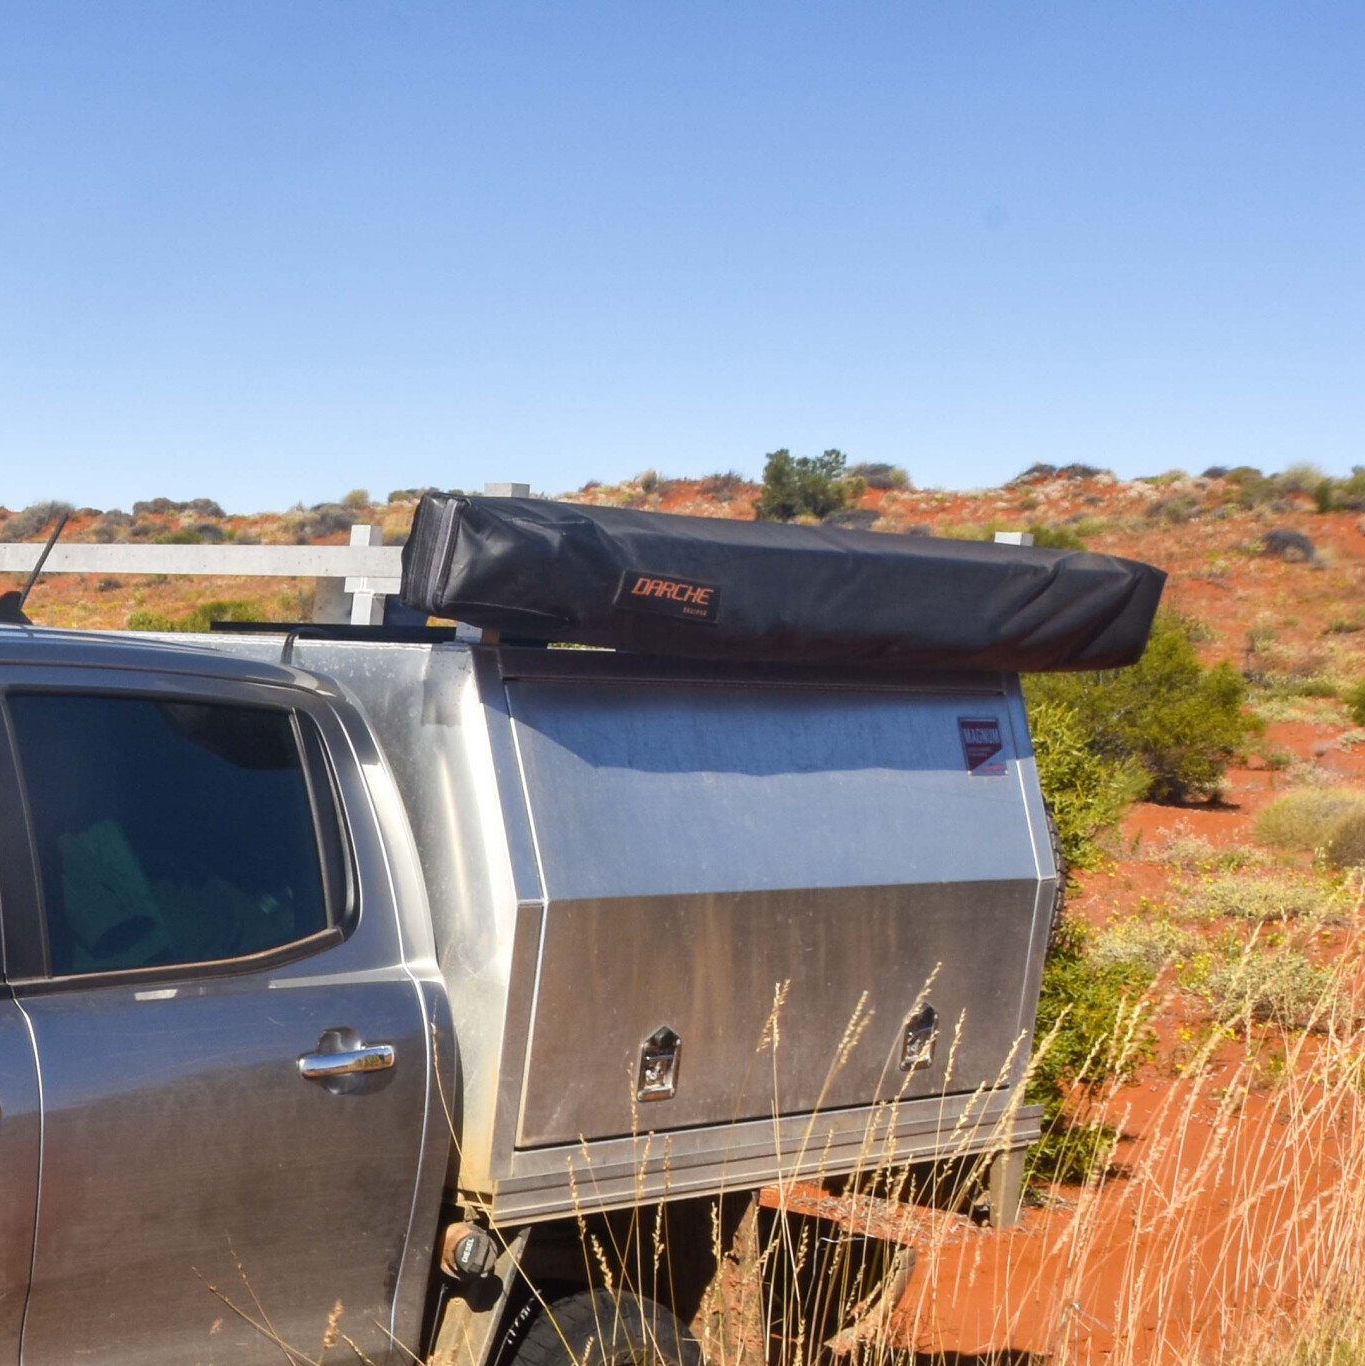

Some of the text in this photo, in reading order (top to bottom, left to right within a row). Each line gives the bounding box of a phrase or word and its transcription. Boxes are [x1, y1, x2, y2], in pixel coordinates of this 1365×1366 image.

[631, 577, 714, 605] DARCHE
[963, 727, 1000, 744] MAGNUM
[461, 1237, 474, 1263] DIESEL
